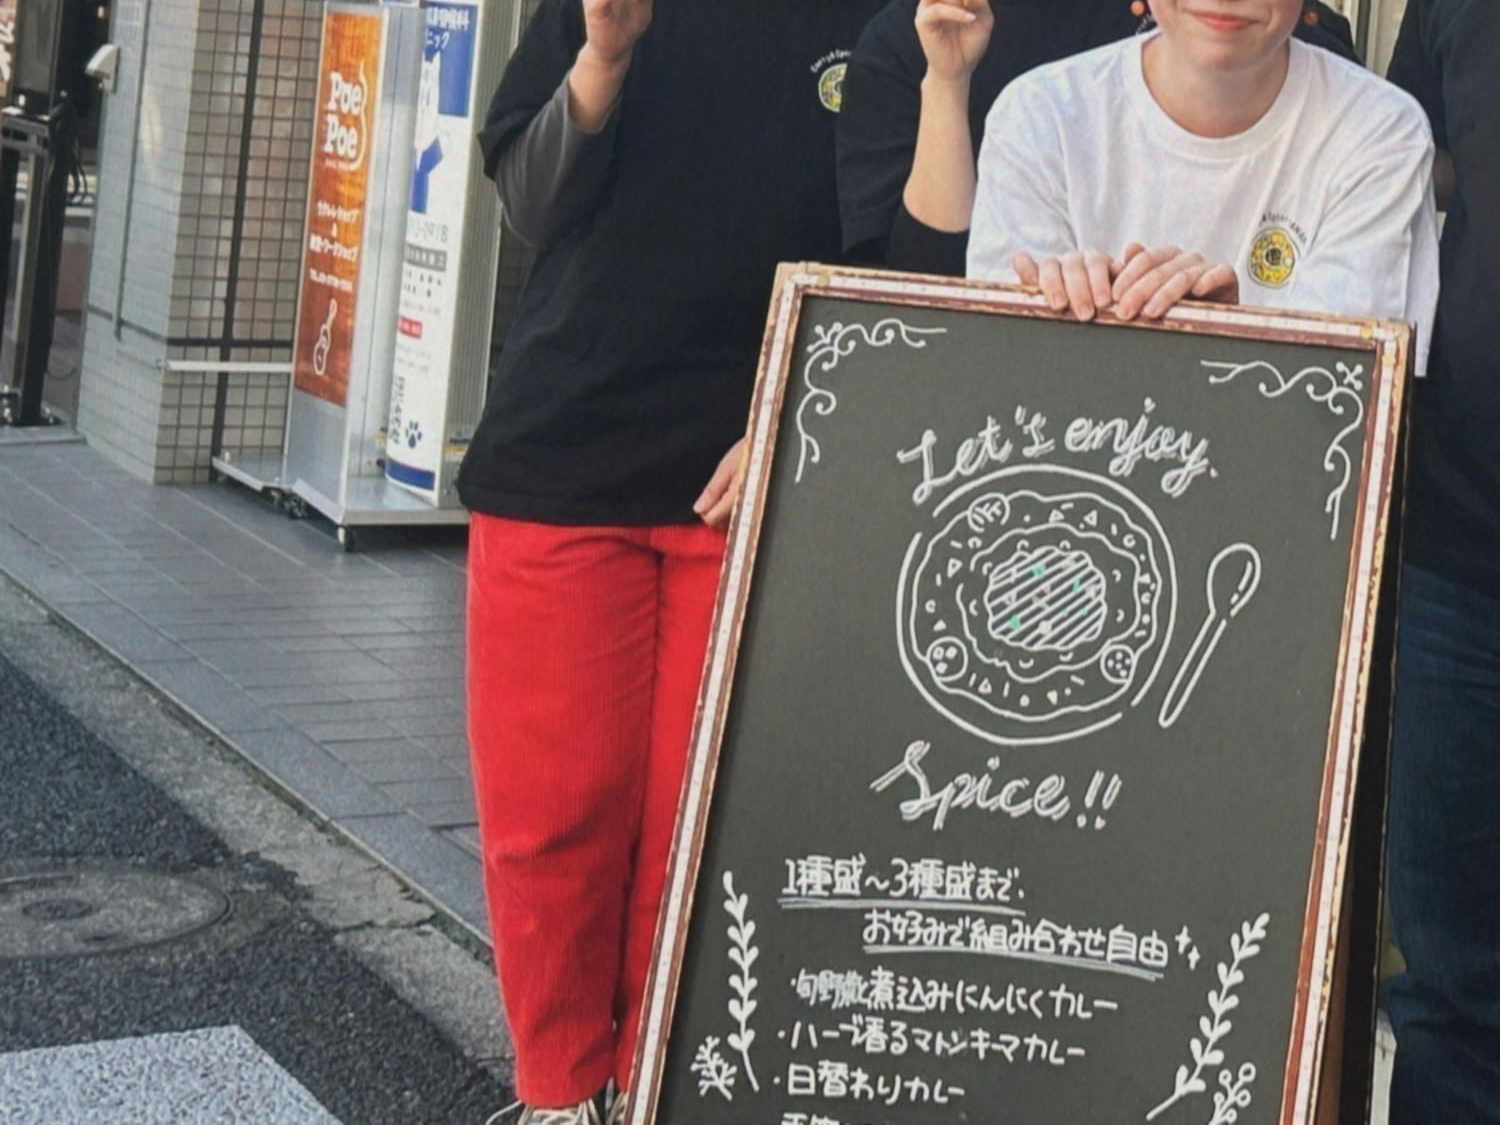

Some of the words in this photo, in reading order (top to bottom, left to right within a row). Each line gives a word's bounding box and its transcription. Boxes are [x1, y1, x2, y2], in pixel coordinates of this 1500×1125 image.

[327, 71, 363, 116] Poe
[323, 113, 358, 160] Poe
[896, 404, 1055, 506] Let's
[861, 908, 1169, 967] お好みで組み合わせ自由
